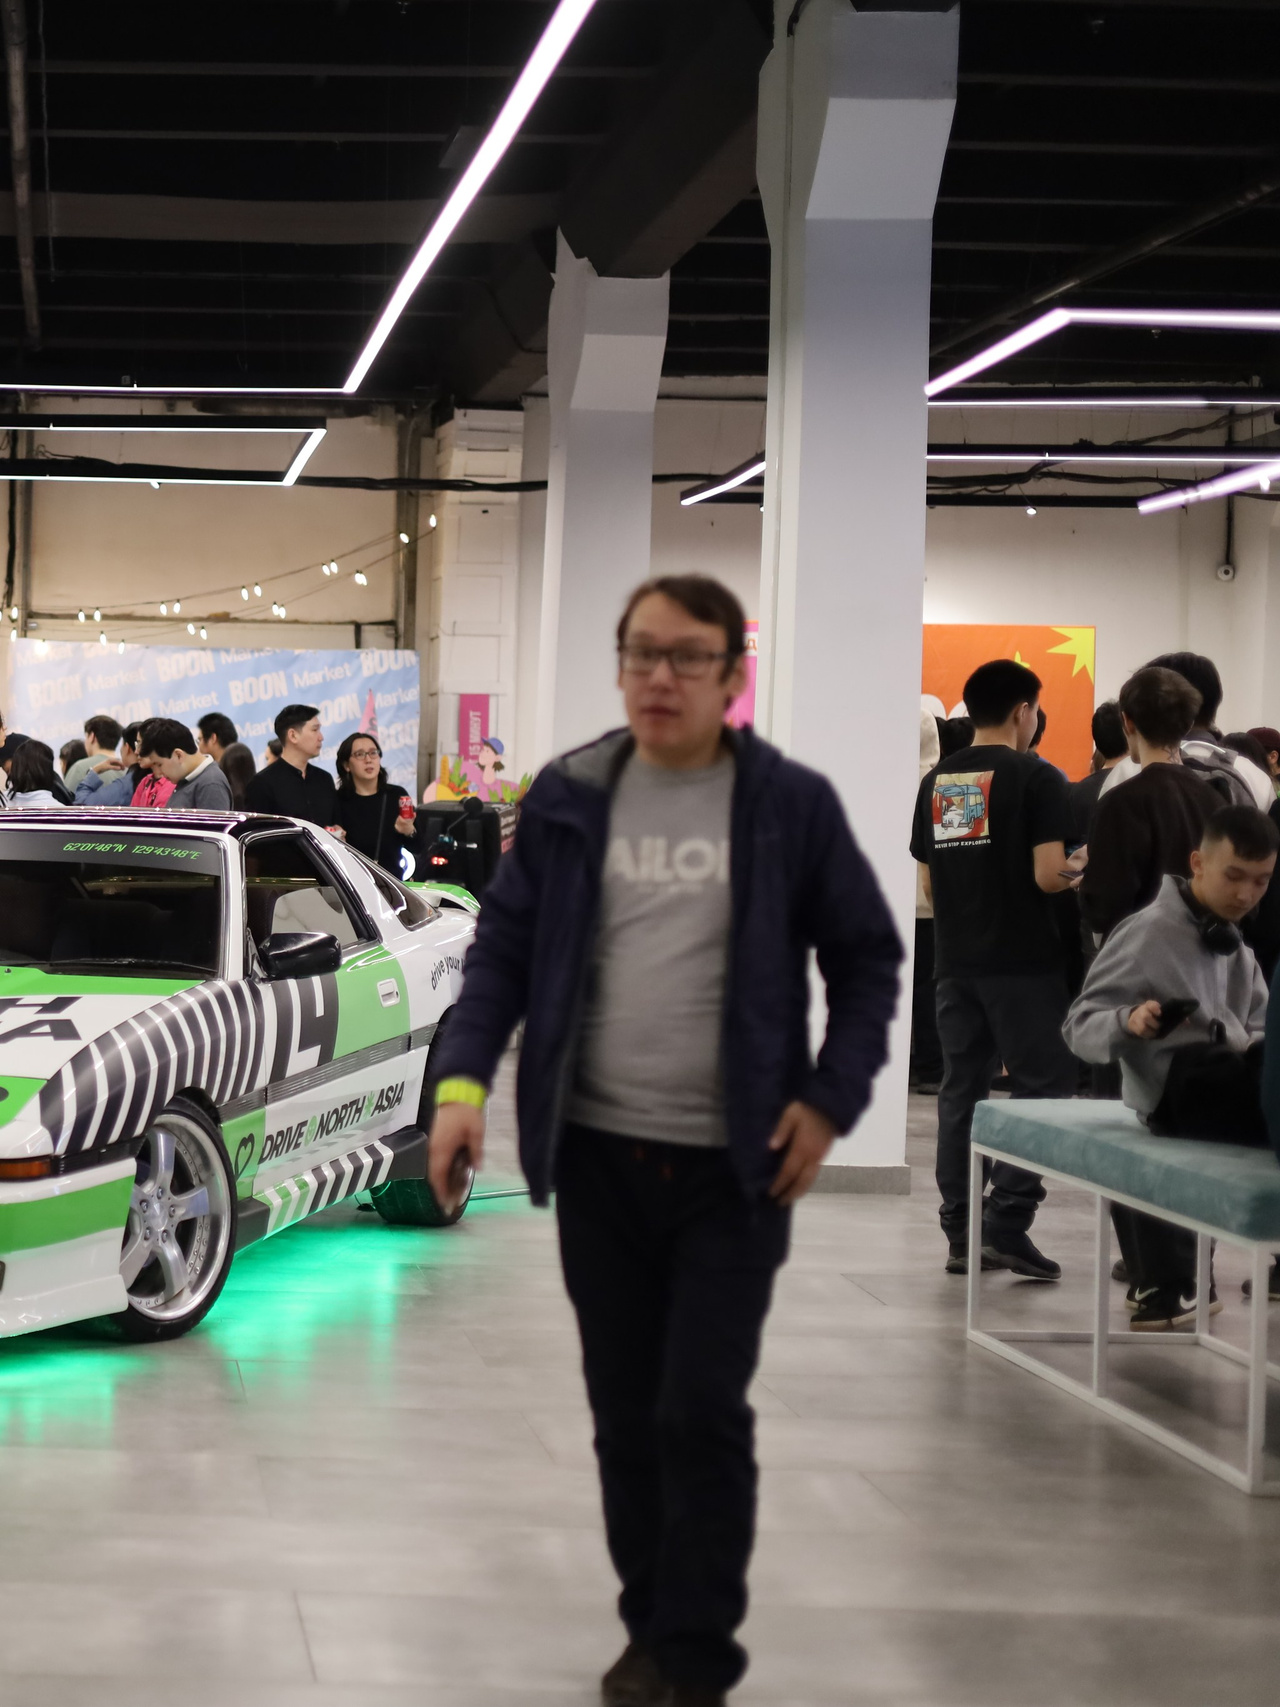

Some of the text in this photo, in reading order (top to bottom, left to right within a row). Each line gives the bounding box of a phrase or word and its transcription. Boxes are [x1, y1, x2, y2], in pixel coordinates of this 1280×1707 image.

[86, 667, 147, 691] Market
[156, 650, 216, 683] BOON
[158, 691, 219, 716] Market
[229, 671, 288, 707] BOON
[293, 662, 352, 689] Market
[310, 693, 361, 727] OON
[602, 836, 730, 883] AILO
[960, 838, 992, 846] EXPLORING
[431, 959, 445, 991] drive
[444, 956, 460, 975] your
[258, 1081, 406, 1165] DRIVE NORTH ASIA
